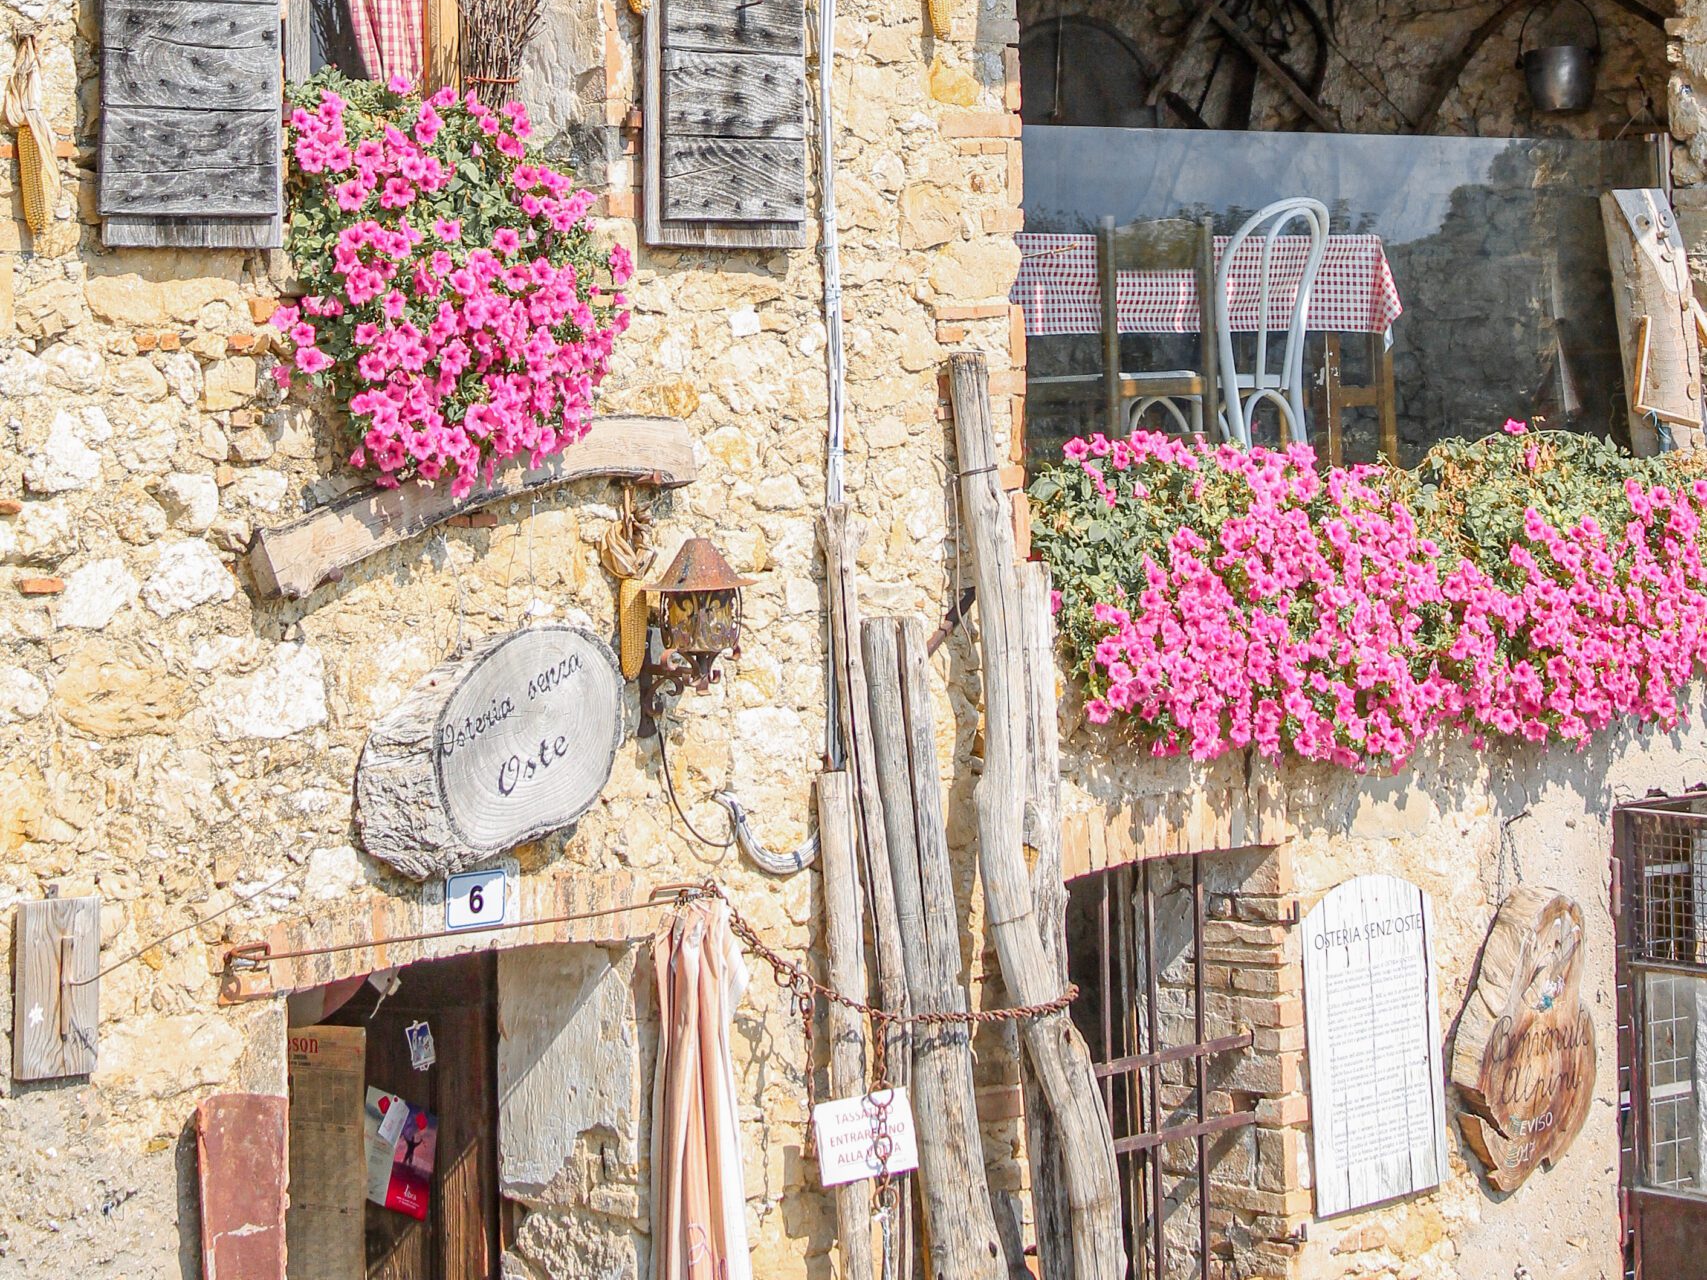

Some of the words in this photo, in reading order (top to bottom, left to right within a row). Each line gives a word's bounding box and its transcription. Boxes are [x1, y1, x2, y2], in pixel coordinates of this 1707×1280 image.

[439, 695, 515, 758] Osteria
[527, 650, 584, 700] senza
[497, 732, 570, 798] Oste
[468, 884, 485, 914] 6
[1314, 921, 1362, 951] OSTERIA
[1491, 1006, 1590, 1064] Benvenuti
[1500, 1068, 1581, 1107] Alpini
[835, 1105, 893, 1125] TASSATIO
[837, 1150, 863, 1165] ALLA
[867, 1142, 902, 1158] VOLA
